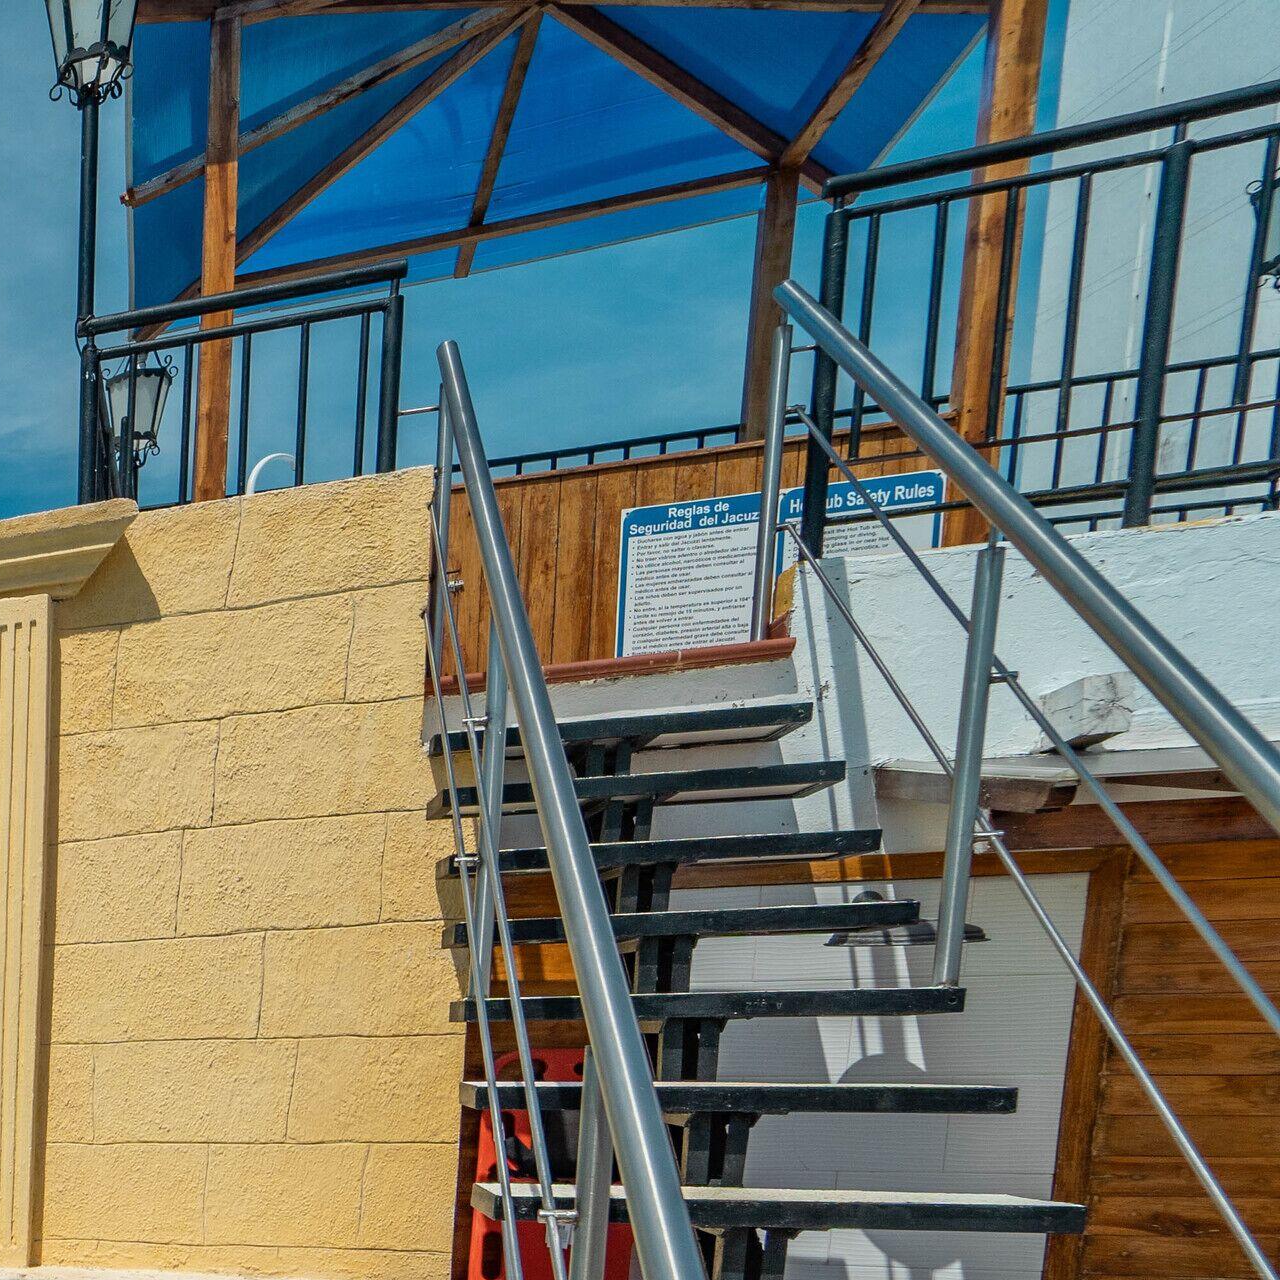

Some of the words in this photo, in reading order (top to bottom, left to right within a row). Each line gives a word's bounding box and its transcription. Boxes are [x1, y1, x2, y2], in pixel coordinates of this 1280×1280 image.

[825, 493, 842, 509] ub
[894, 483, 935, 500] Rules
[668, 504, 711, 519] Reglas
[714, 501, 730, 513] de
[629, 519, 692, 535] Seguridad
[699, 515, 718, 527] del
[721, 511, 760, 524] Jacuz
